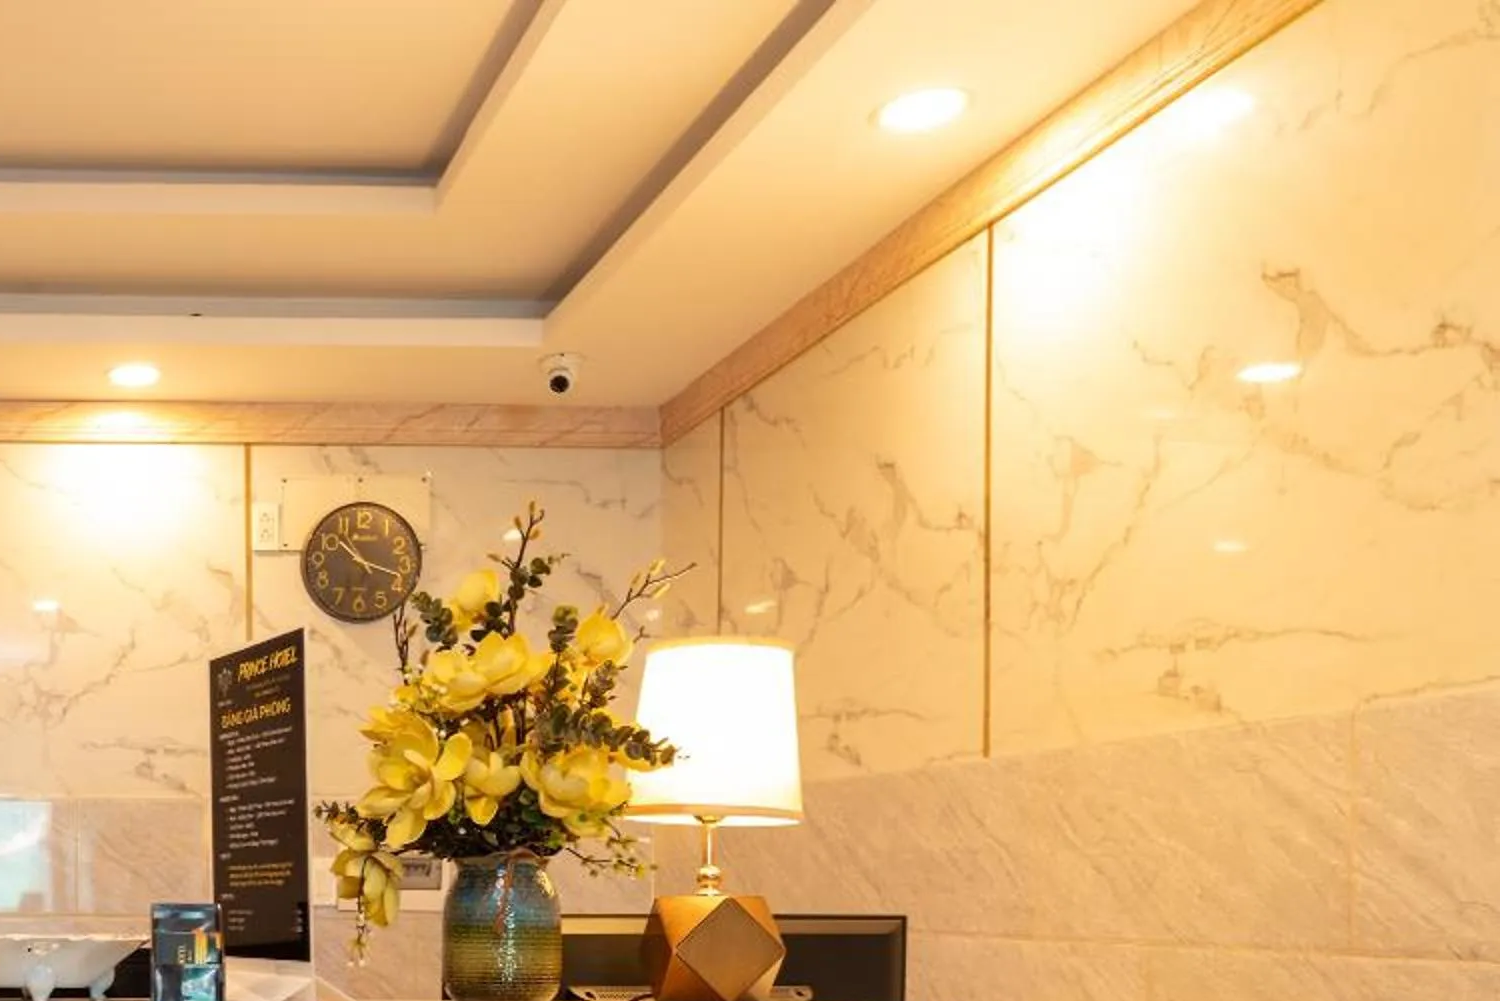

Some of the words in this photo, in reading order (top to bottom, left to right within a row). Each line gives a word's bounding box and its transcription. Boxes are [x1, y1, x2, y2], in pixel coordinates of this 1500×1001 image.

[357, 510, 373, 529] 12
[384, 518, 390, 536] 1
[321, 533, 340, 551] 10
[392, 536, 406, 555] 2
[311, 551, 325, 569] 9
[399, 556, 411, 575] 3
[316, 571, 329, 589] 8
[391, 576, 404, 591] 4
[332, 586, 345, 605] 7
[352, 592, 365, 612] 6
[374, 591, 387, 609] 5
[238, 655, 268, 682] PRINCE
[269, 645, 298, 669] HOTEL
